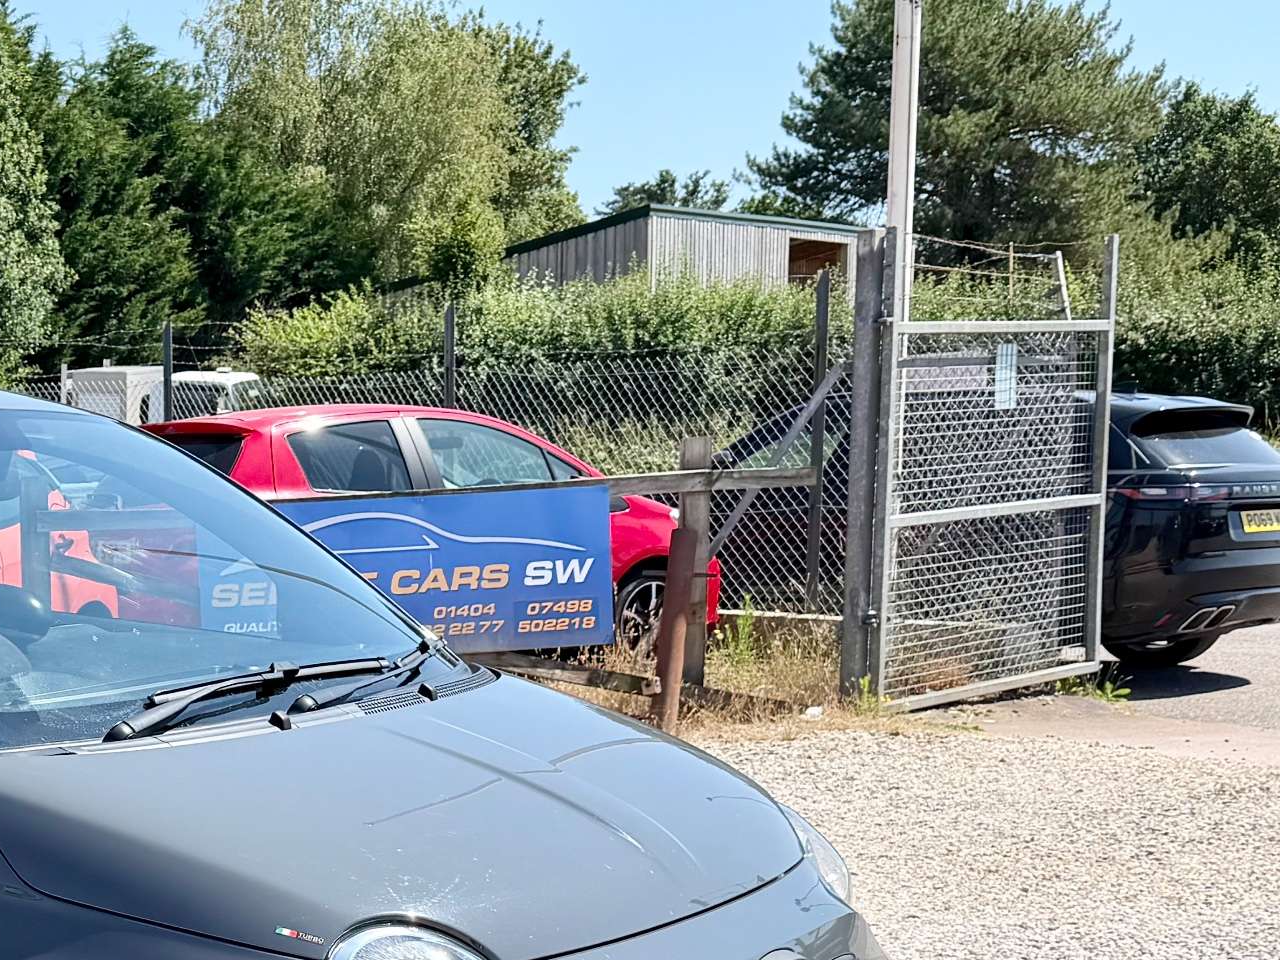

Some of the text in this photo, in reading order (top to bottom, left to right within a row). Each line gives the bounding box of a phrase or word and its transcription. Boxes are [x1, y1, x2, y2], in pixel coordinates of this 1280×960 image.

[390, 557, 595, 595] CARS SW
[433, 603, 496, 619] 01404
[526, 599, 593, 616] 07498
[448, 622, 476, 636] 22
[479, 620, 505, 634] 77
[517, 616, 596, 633] 502218
